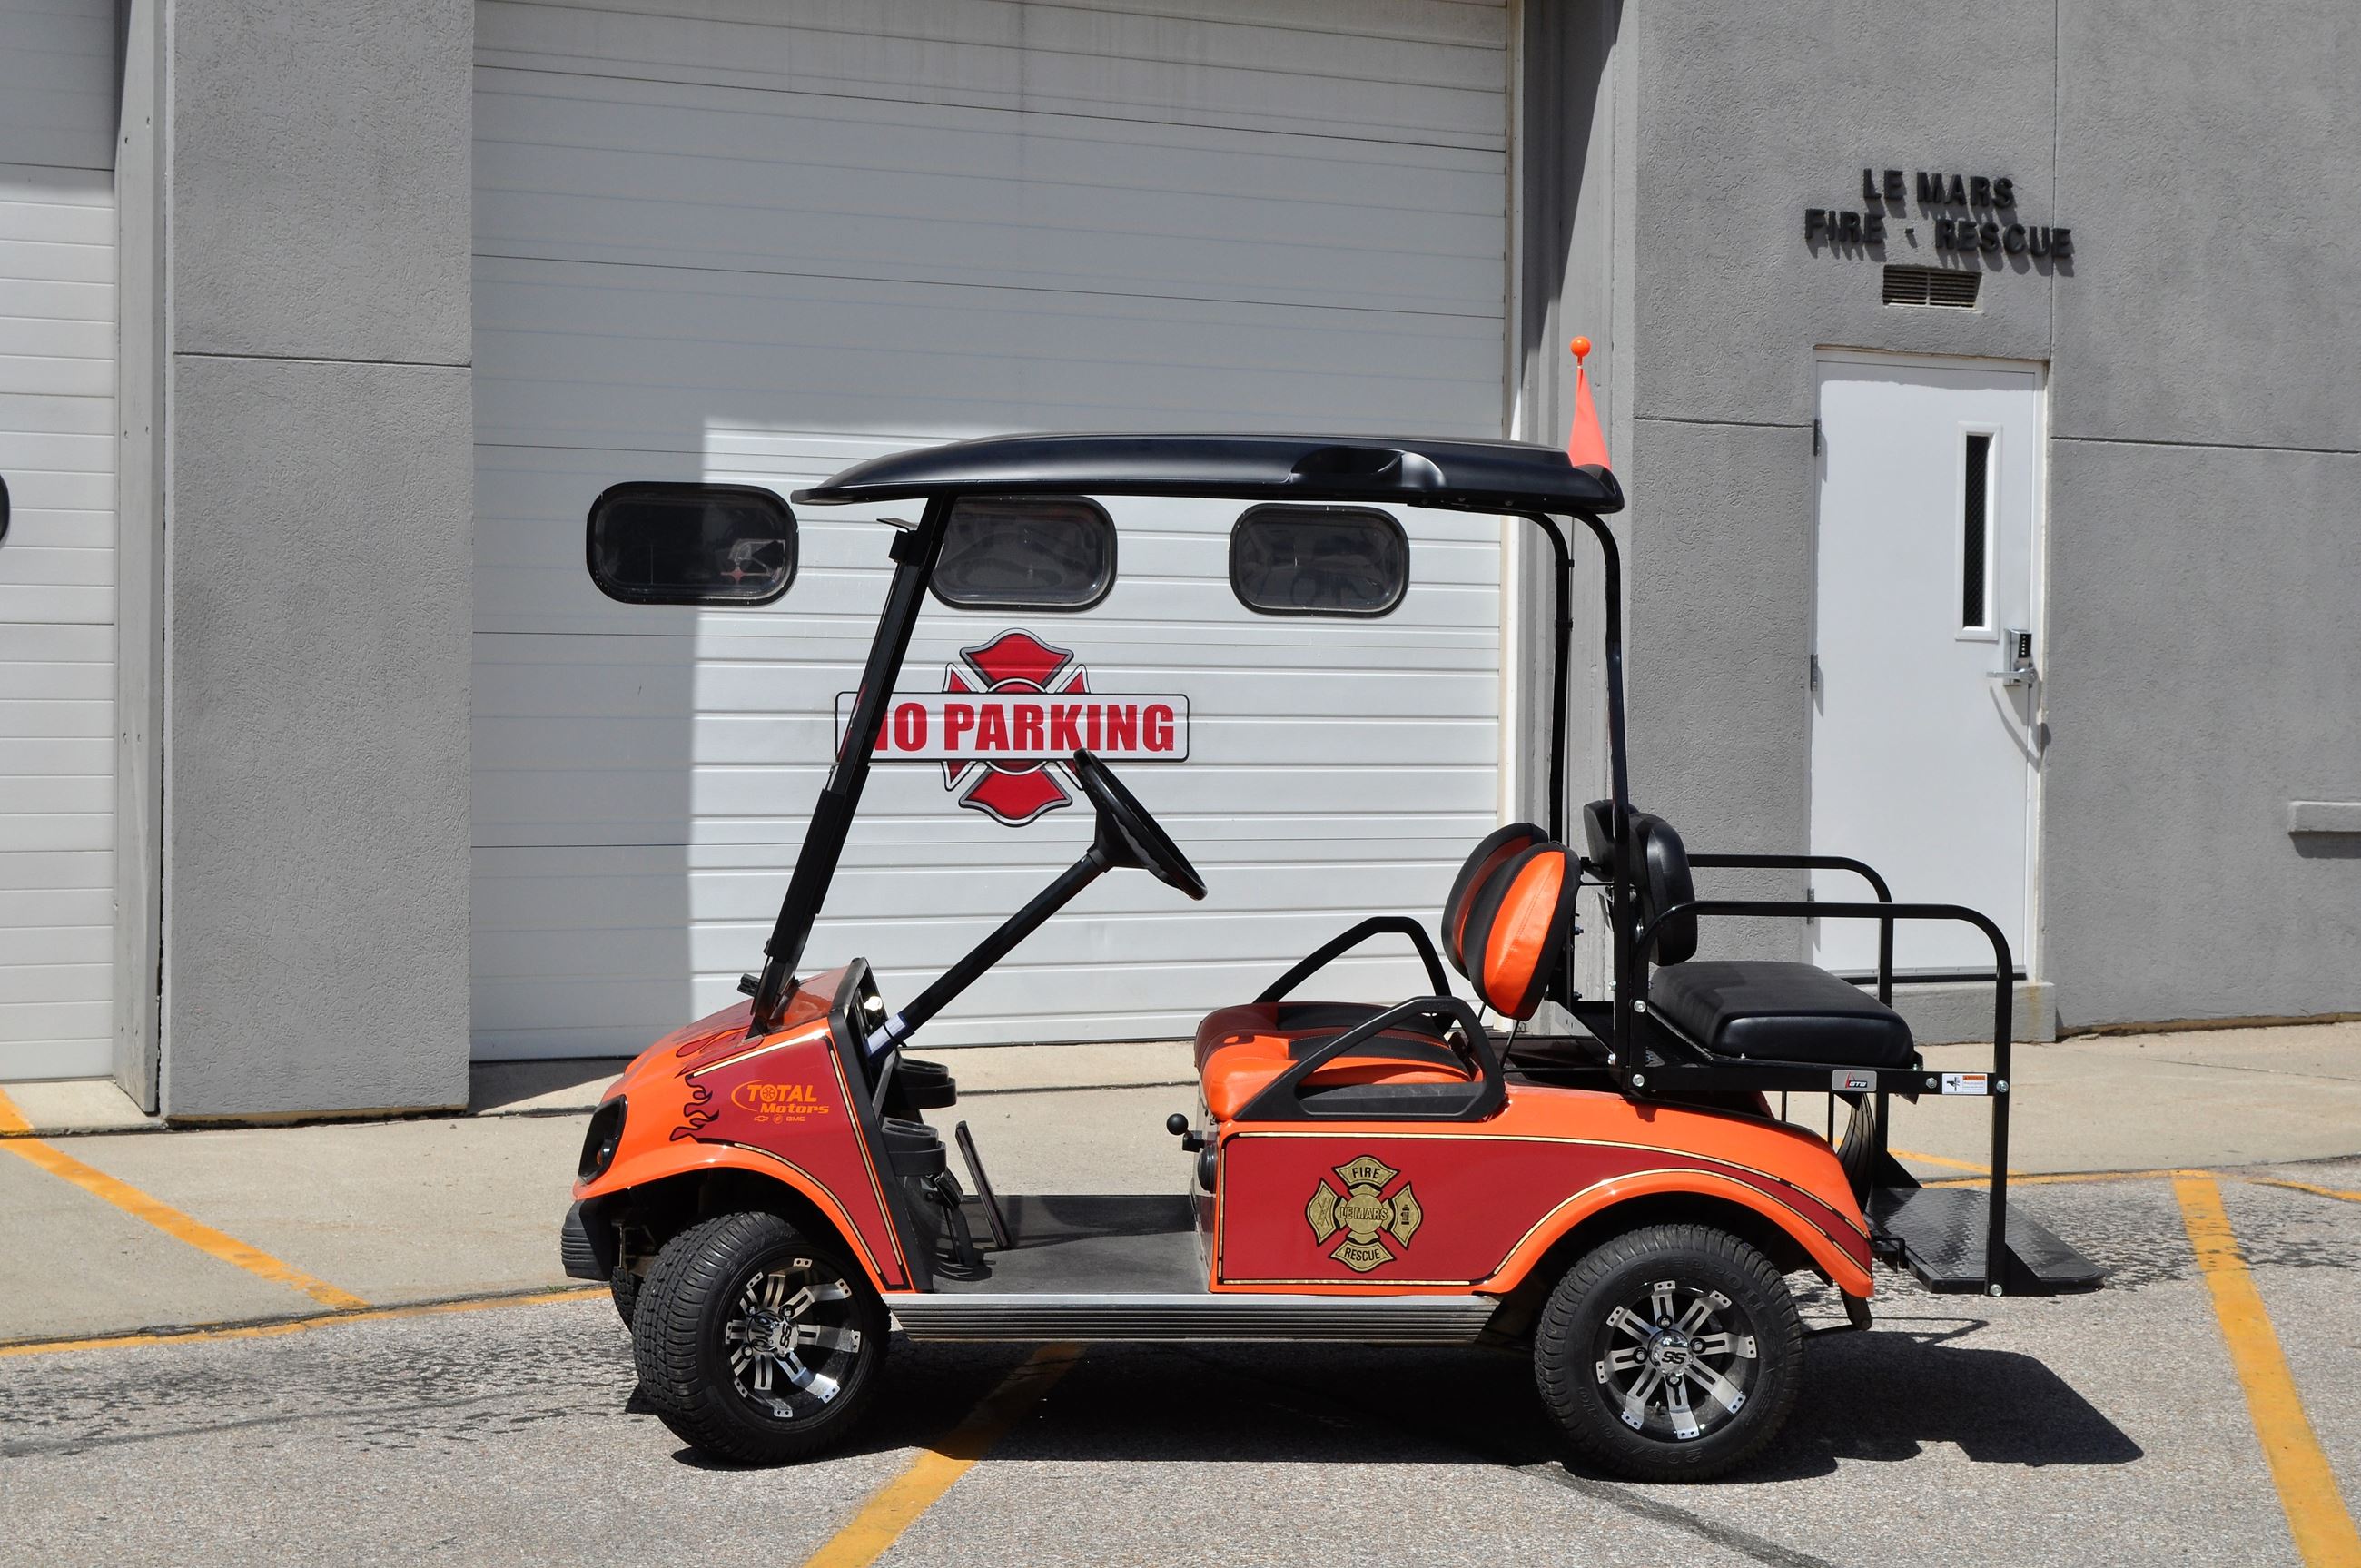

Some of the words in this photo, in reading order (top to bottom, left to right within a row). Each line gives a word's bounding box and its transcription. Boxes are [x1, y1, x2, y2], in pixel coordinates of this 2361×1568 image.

[1863, 168, 1904, 200] LE
[1916, 171, 2014, 209] MARS
[1803, 208, 1884, 244] FIRE
[1934, 217, 2072, 259] RESCUE
[873, 701, 928, 752] O
[943, 703, 1175, 753] PARKING
[746, 1084, 817, 1103] TOTAL
[760, 1102, 830, 1114] Motors
[1351, 1166, 1381, 1179] FIRE
[1344, 1247, 1381, 1262] RESCUE
[779, 1324, 793, 1349] SS
[1661, 1350, 1687, 1365] SS
